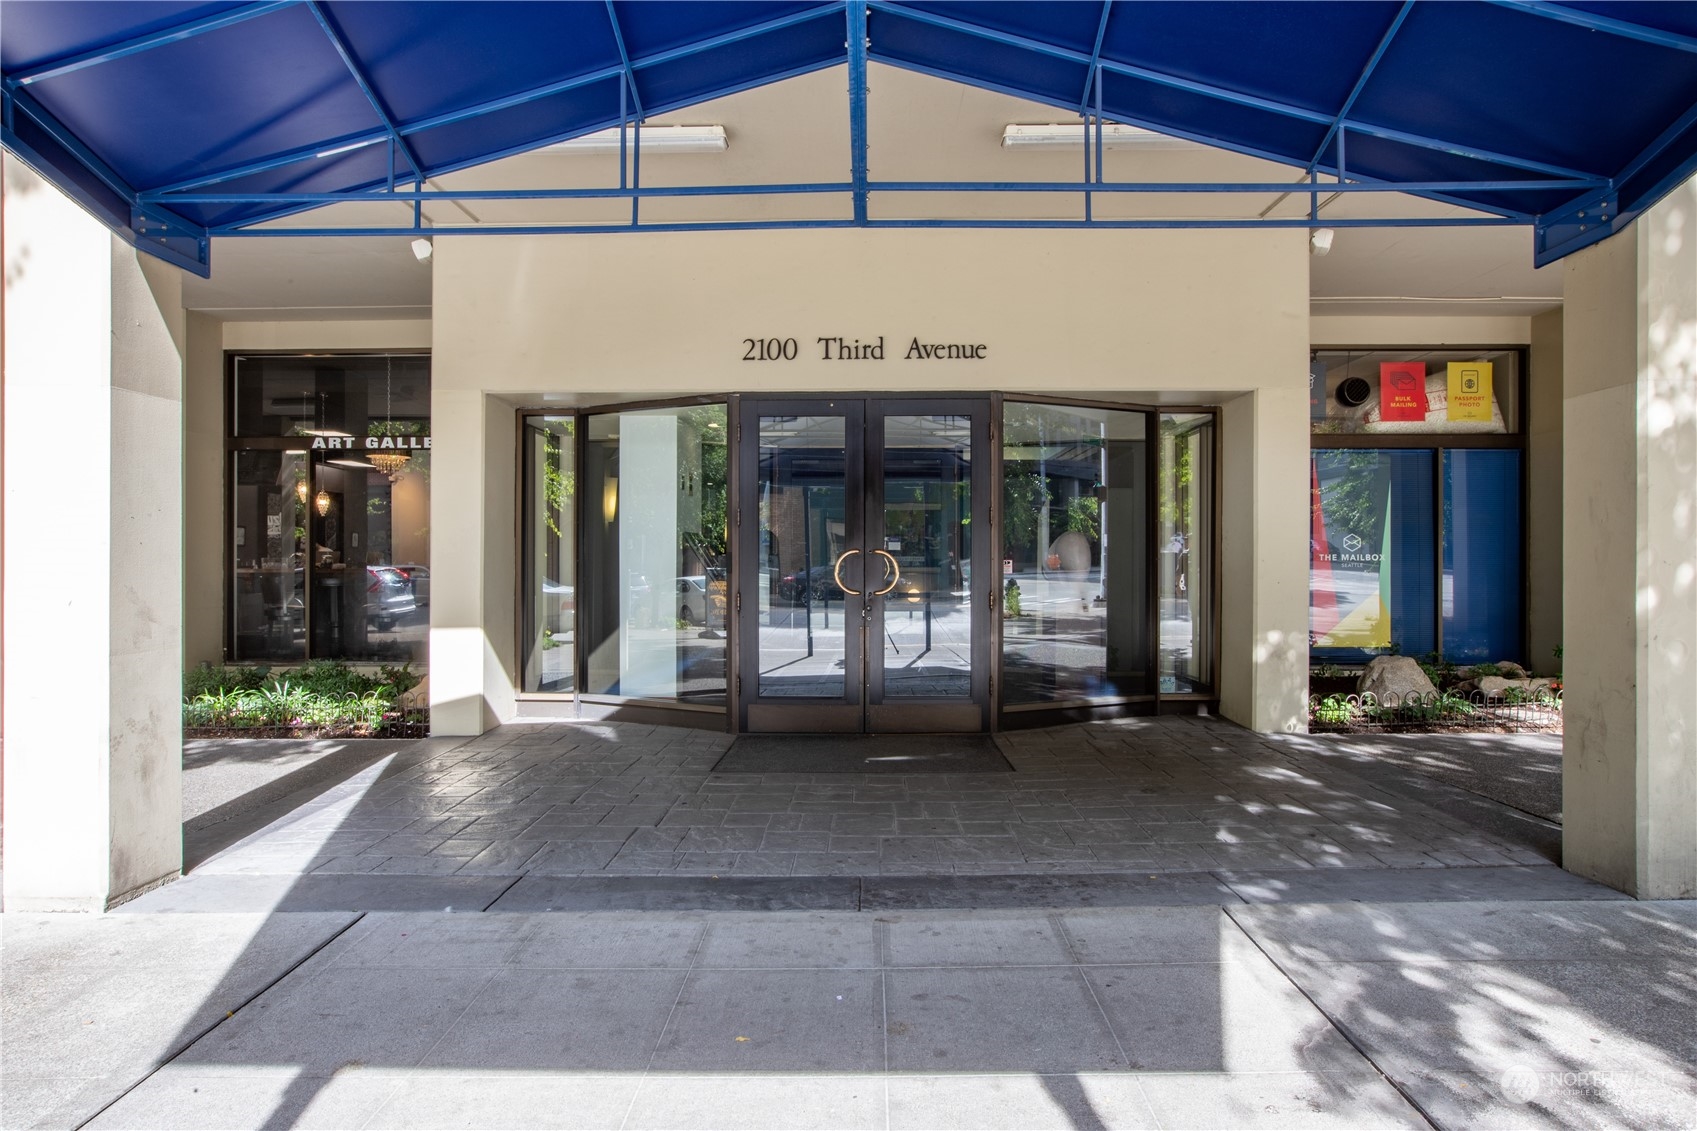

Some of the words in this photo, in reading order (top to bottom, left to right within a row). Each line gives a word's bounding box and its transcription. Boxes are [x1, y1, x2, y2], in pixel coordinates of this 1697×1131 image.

[742, 338, 798, 361] 2100
[817, 336, 885, 360] Third
[904, 337, 988, 360] Avenue
[311, 437, 355, 449] ART
[1319, 553, 1338, 561] THE
[1341, 553, 1385, 561] MAILBOX
